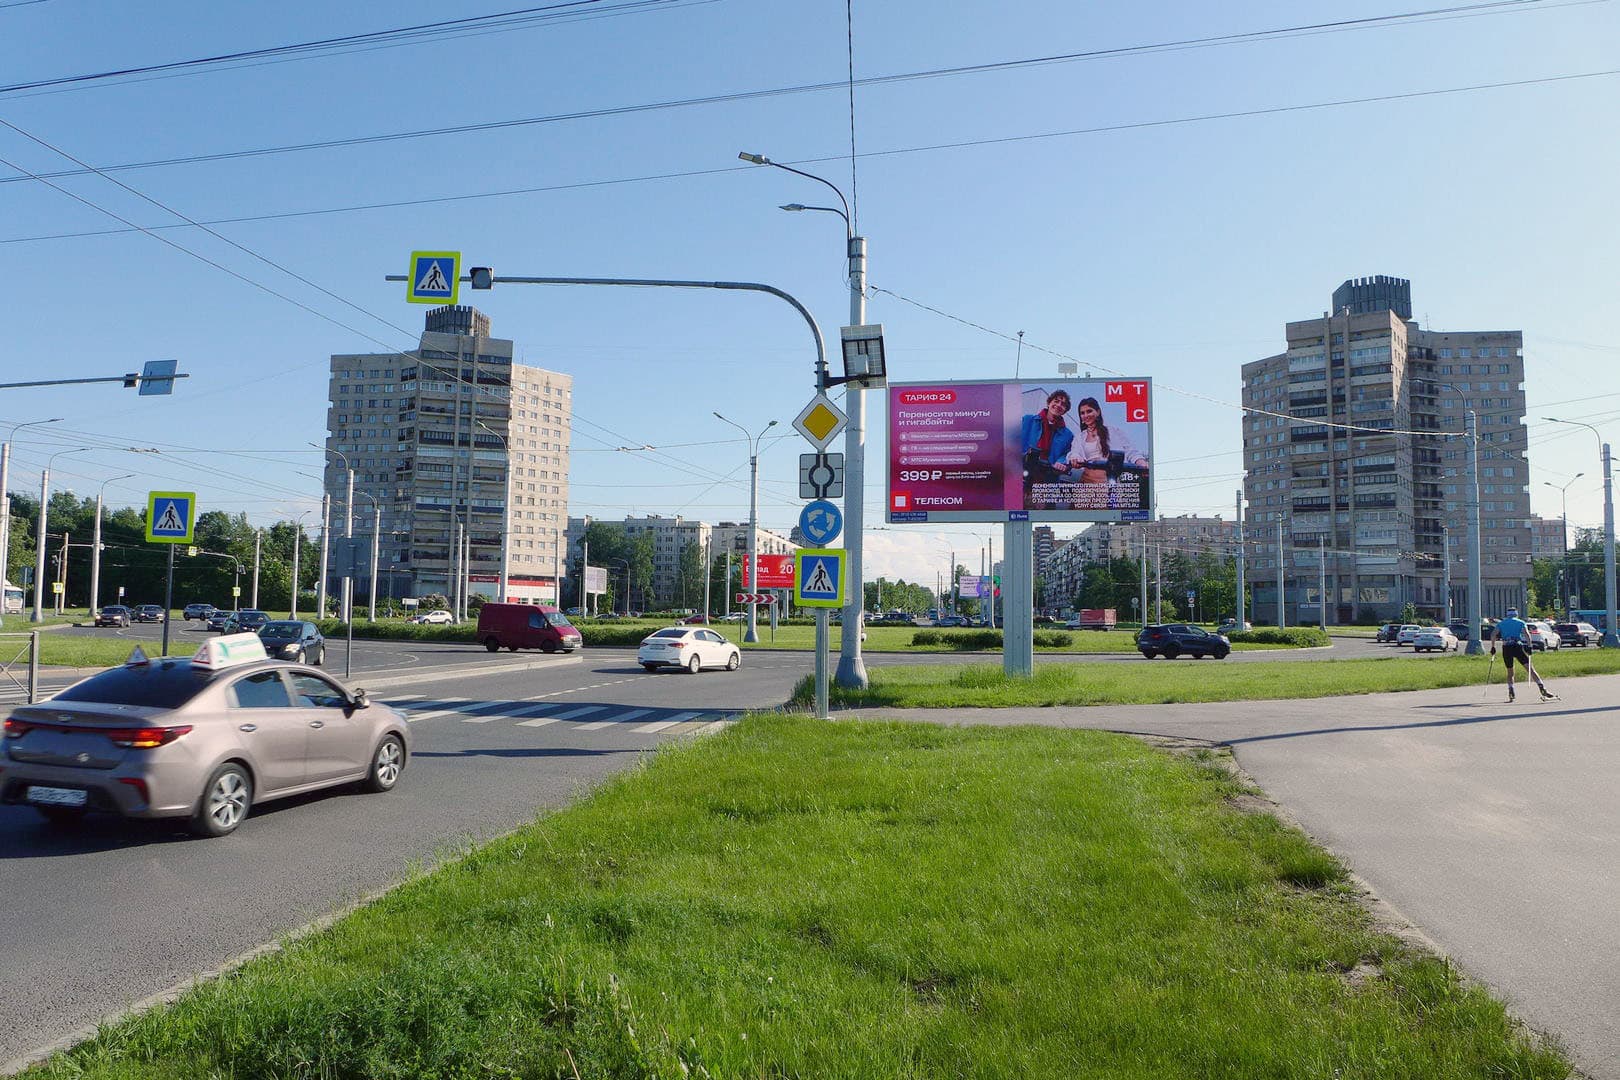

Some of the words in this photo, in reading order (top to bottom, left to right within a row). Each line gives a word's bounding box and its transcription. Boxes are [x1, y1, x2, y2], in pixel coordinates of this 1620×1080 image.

[899, 411, 954, 419] Переносите
[955, 410, 990, 418] минуты
[900, 470, 930, 481] 399
[931, 470, 943, 480] ₽
[1123, 472, 1140, 480] 18+
[915, 497, 963, 505] ТЕЛЕКОМ
